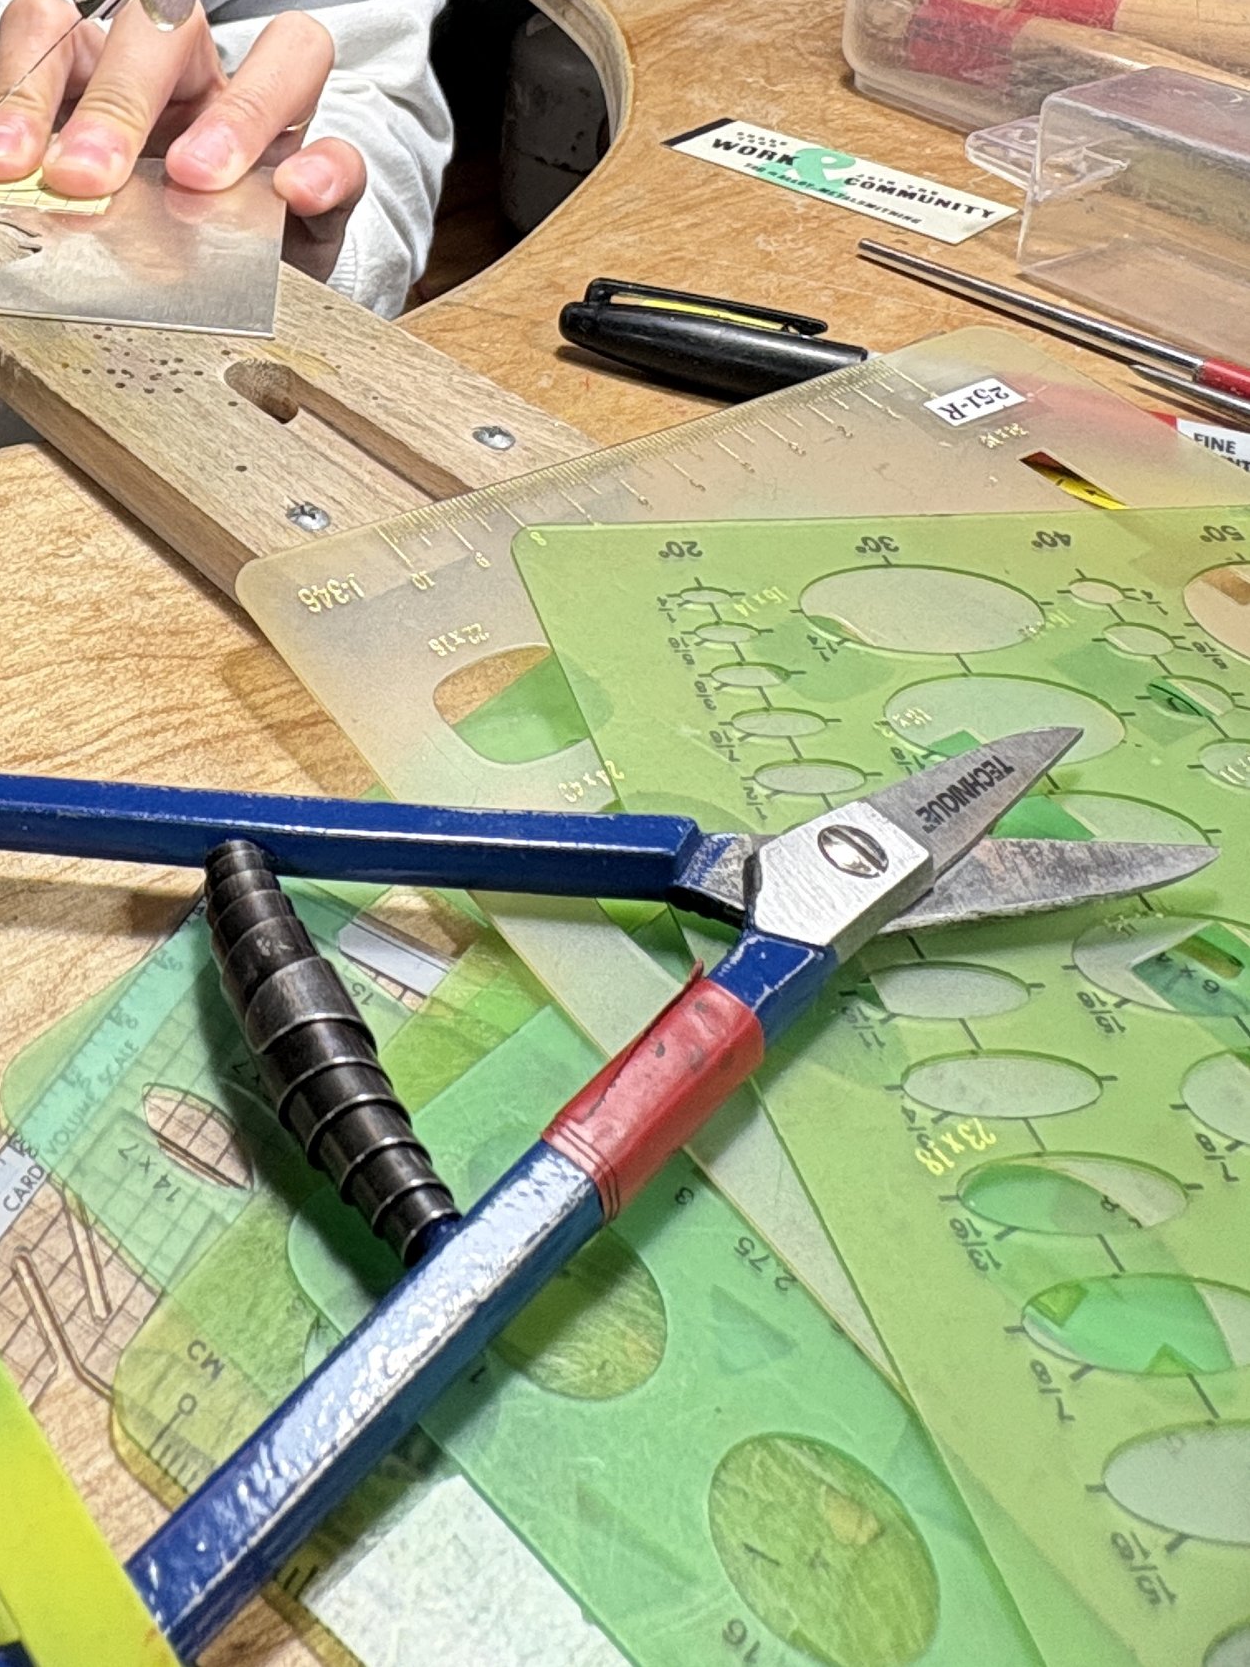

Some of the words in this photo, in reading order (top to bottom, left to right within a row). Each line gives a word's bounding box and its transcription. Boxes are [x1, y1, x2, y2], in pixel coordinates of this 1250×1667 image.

[711, 137, 799, 166] WORK
[843, 176, 998, 220] COMMUNITY
[938, 385, 1011, 421] 251-R
[1193, 432, 1237, 455] FINE
[529, 530, 548, 547] 8
[855, 536, 900, 554] 30°
[1031, 530, 1072, 549] 40°
[1200, 524, 1246, 543] 50°
[659, 540, 703, 558] 20°
[409, 570, 435, 591] 10
[915, 754, 1015, 826] TECHNIQUE
[958, 1118, 997, 1152] 23
[915, 1146, 955, 1176] 18
[2, 1164, 46, 1212] CARD
[152, 1172, 182, 1203] 14
[186, 1339, 227, 1382] CM
